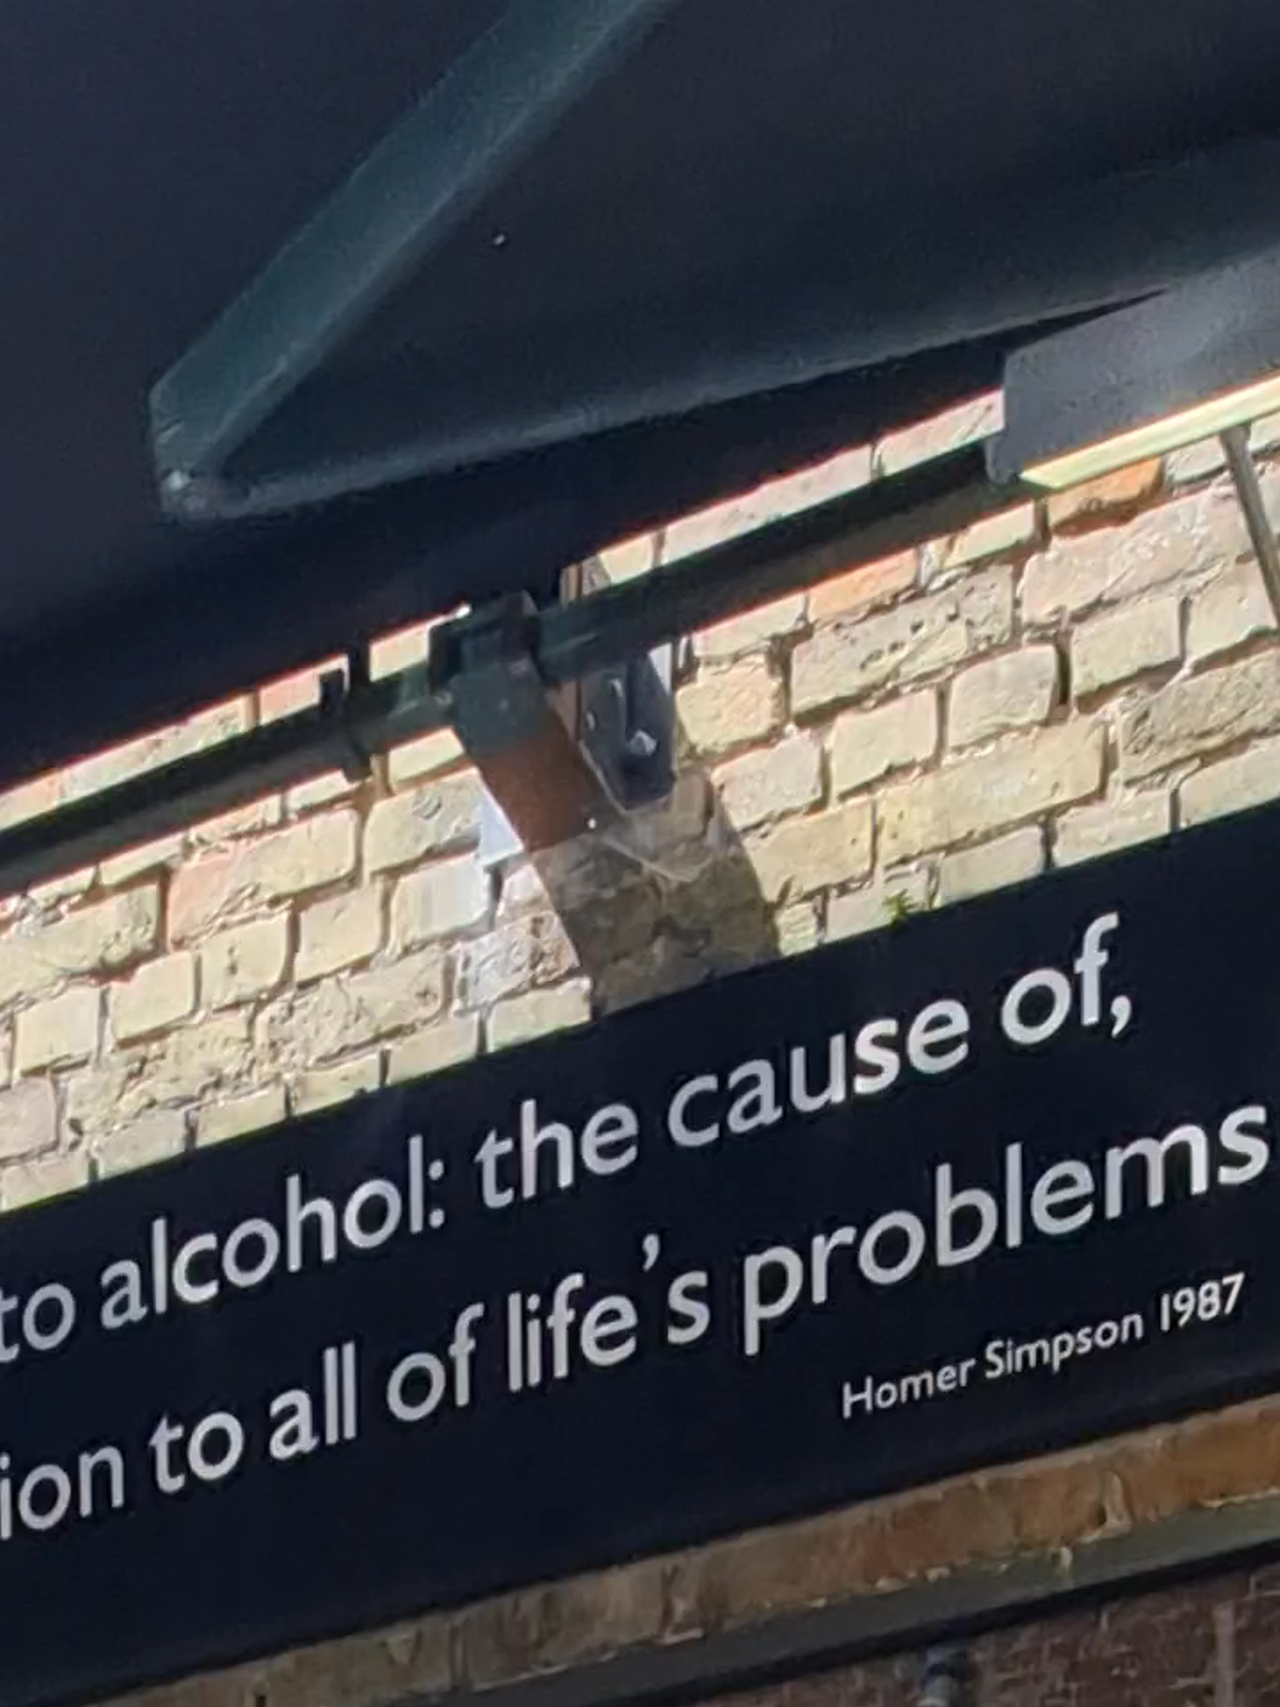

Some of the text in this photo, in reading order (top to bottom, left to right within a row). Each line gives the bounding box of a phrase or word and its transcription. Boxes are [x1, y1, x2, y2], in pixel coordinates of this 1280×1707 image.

[101, 1135, 446, 1329] alcohol:
[475, 1099, 639, 1208] the
[668, 999, 971, 1147] cause
[1001, 911, 1132, 1045] of,
[149, 1412, 244, 1493] to
[269, 1342, 357, 1460] all
[387, 1303, 485, 1421] of
[508, 1234, 710, 1392] life's
[744, 1105, 1270, 1356] problems
[843, 1271, 1245, 1418] Homer Simpson 1987
